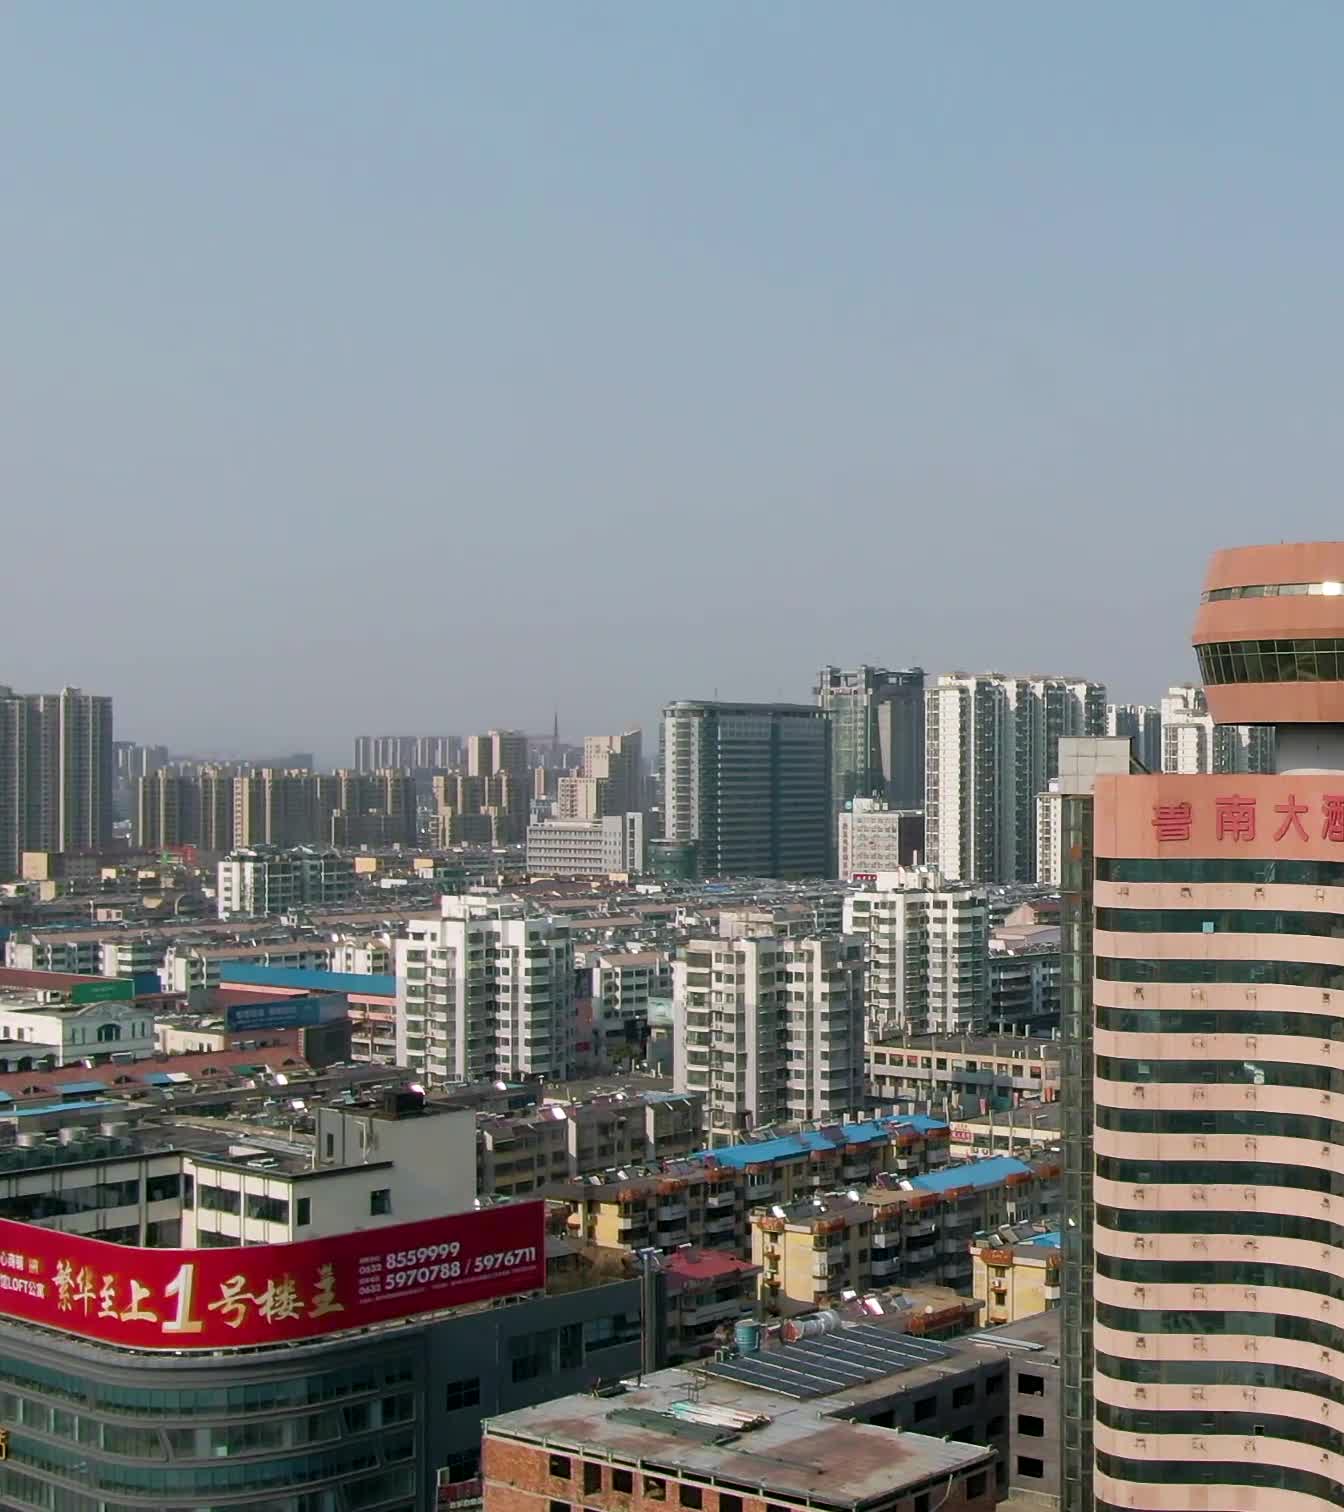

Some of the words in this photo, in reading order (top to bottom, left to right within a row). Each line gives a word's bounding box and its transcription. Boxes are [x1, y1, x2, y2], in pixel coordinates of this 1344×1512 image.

[385, 1262, 460, 1290] 5970788
[474, 1246, 536, 1273] 5976711
[386, 1242, 460, 1269] 8559999
